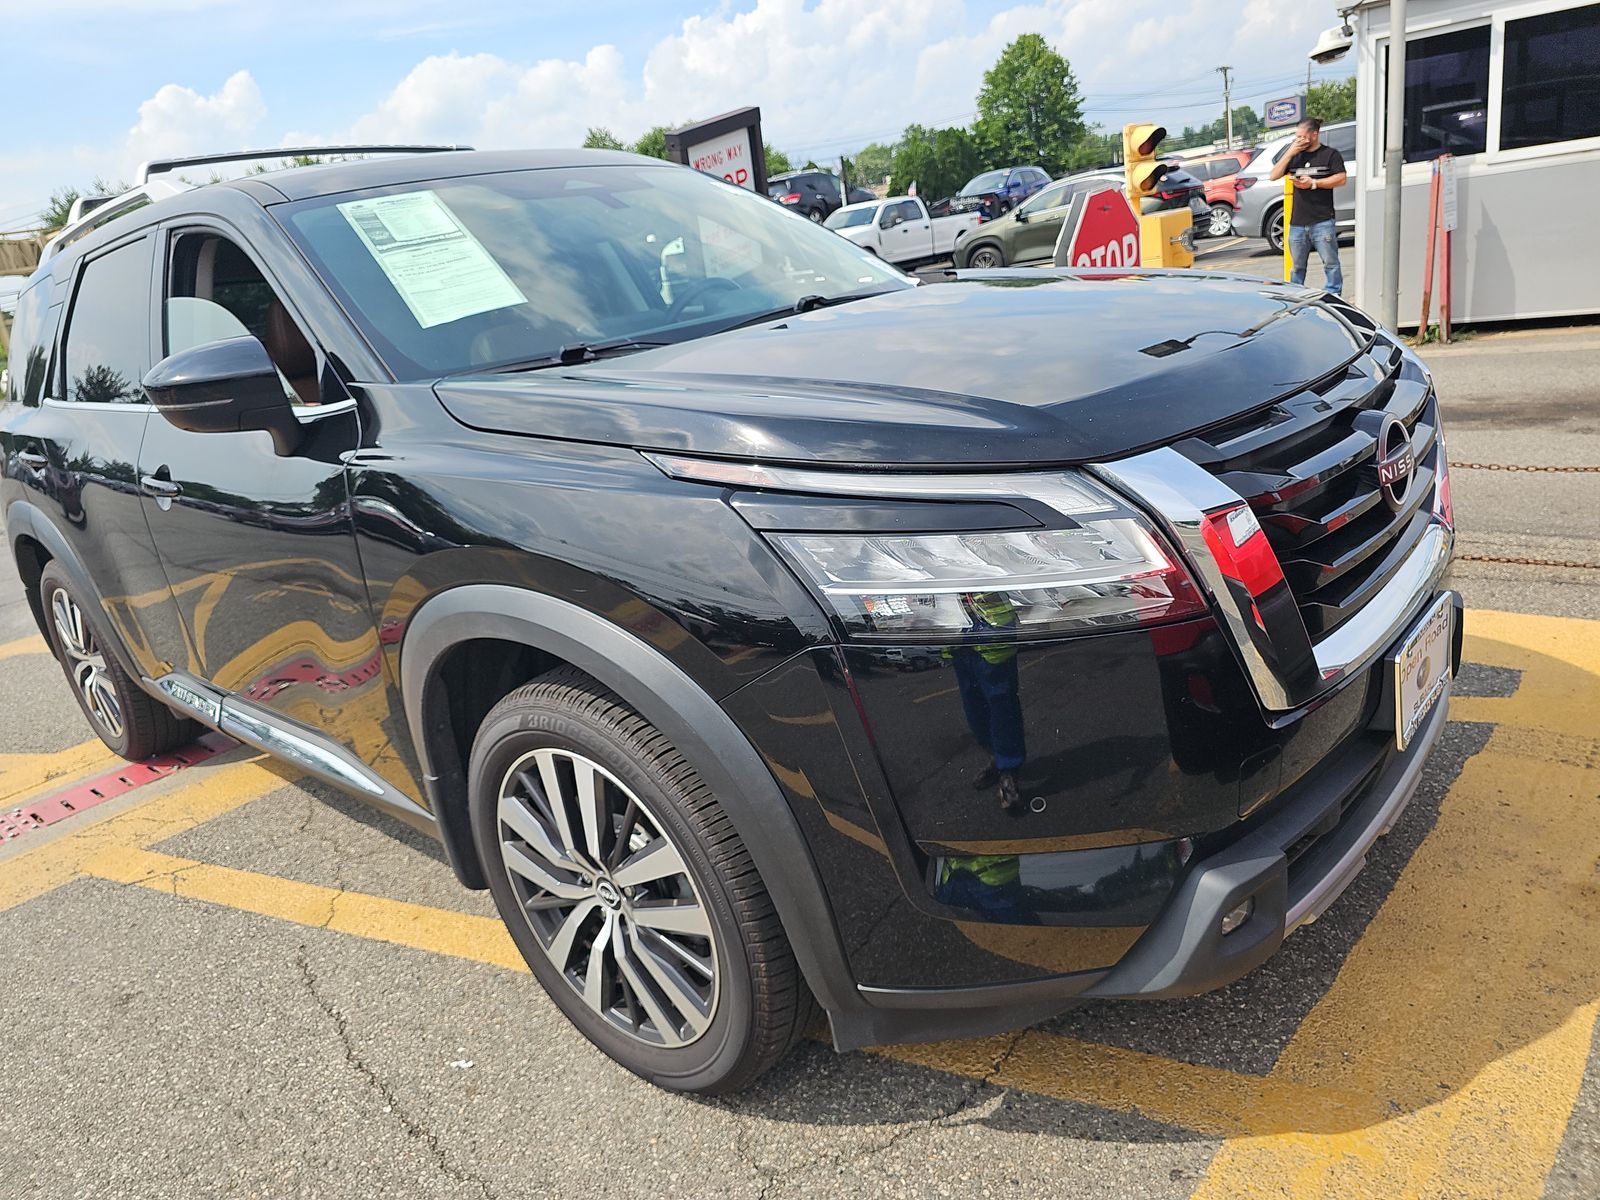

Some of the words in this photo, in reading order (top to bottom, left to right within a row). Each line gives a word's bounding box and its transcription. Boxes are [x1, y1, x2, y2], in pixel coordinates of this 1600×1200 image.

[693, 152, 724, 171] WRONG
[727, 144, 742, 160] WAY
[527, 714, 646, 785] BRIDGESTONE
